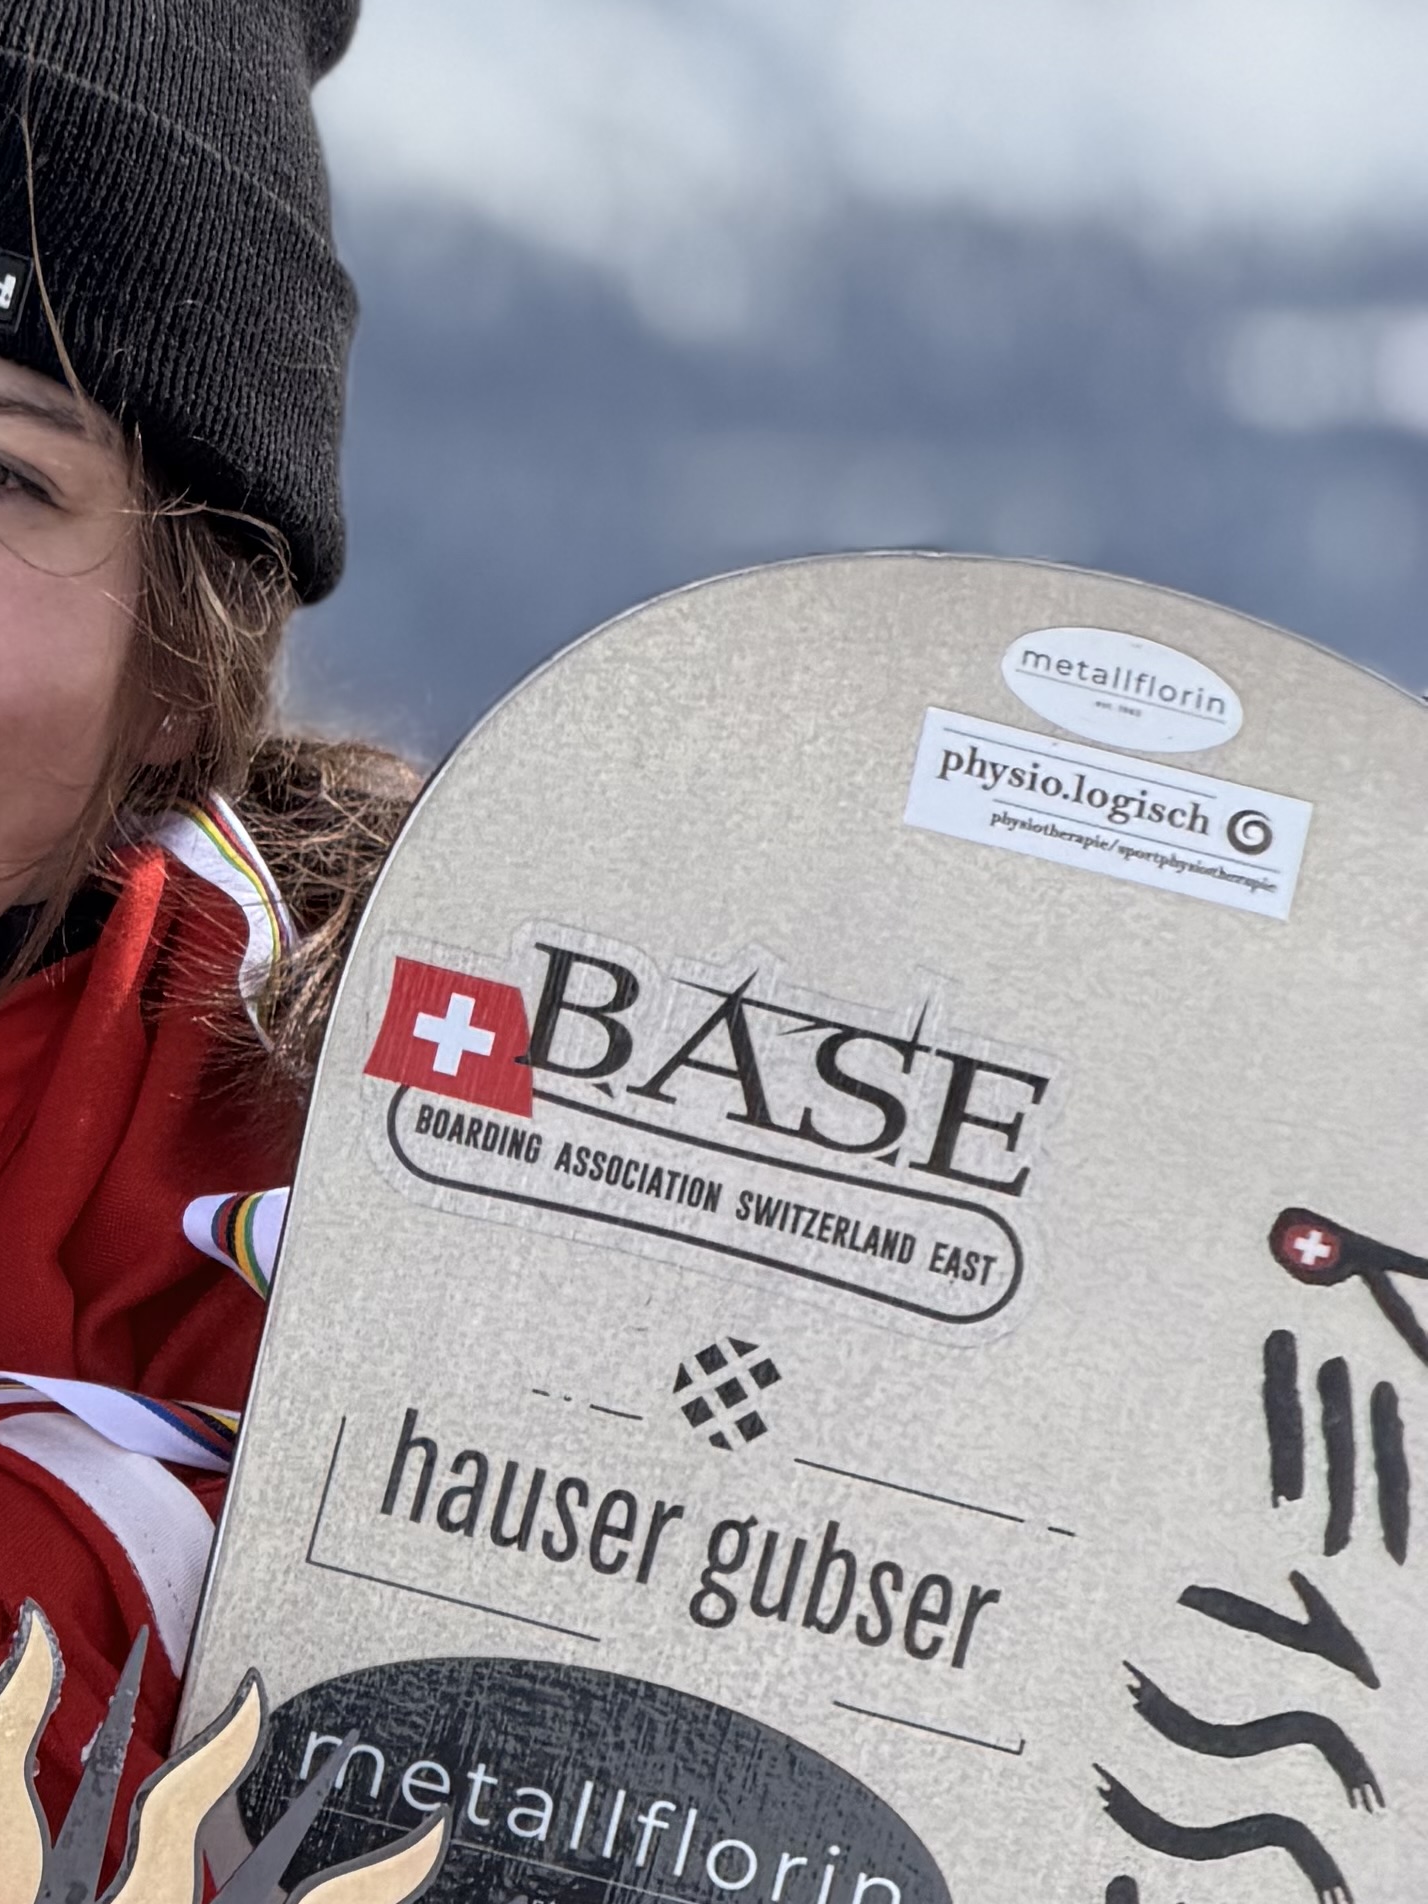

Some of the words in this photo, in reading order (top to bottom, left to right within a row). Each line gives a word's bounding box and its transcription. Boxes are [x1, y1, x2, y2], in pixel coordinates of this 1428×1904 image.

[1020, 647, 1227, 717] metallflorin
[936, 746, 1210, 835] physio.logisch
[514, 941, 1050, 1197] BASE
[414, 1104, 543, 1164] BOARDING
[554, 1141, 722, 1211] ASSOCIATION
[736, 1191, 916, 1265] SWITZERLAND
[929, 1242, 997, 1286] EAST
[380, 1408, 684, 1585] hauser
[689, 1514, 1001, 1669] gubser
